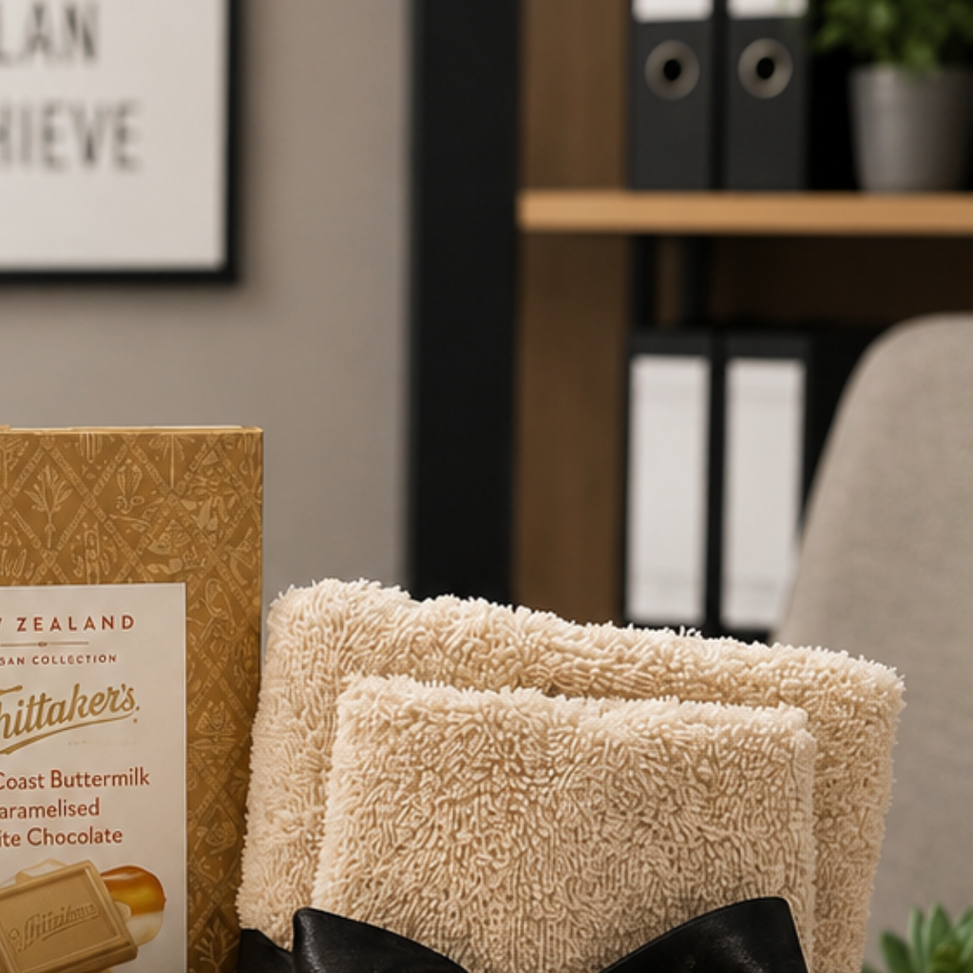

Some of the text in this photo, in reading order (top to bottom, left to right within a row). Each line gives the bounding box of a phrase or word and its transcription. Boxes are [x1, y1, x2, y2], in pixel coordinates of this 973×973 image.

[17, 615, 135, 632] ZEALAND
[50, 766, 150, 789] Buttermilk
[26, 826, 123, 847] Chocolate
